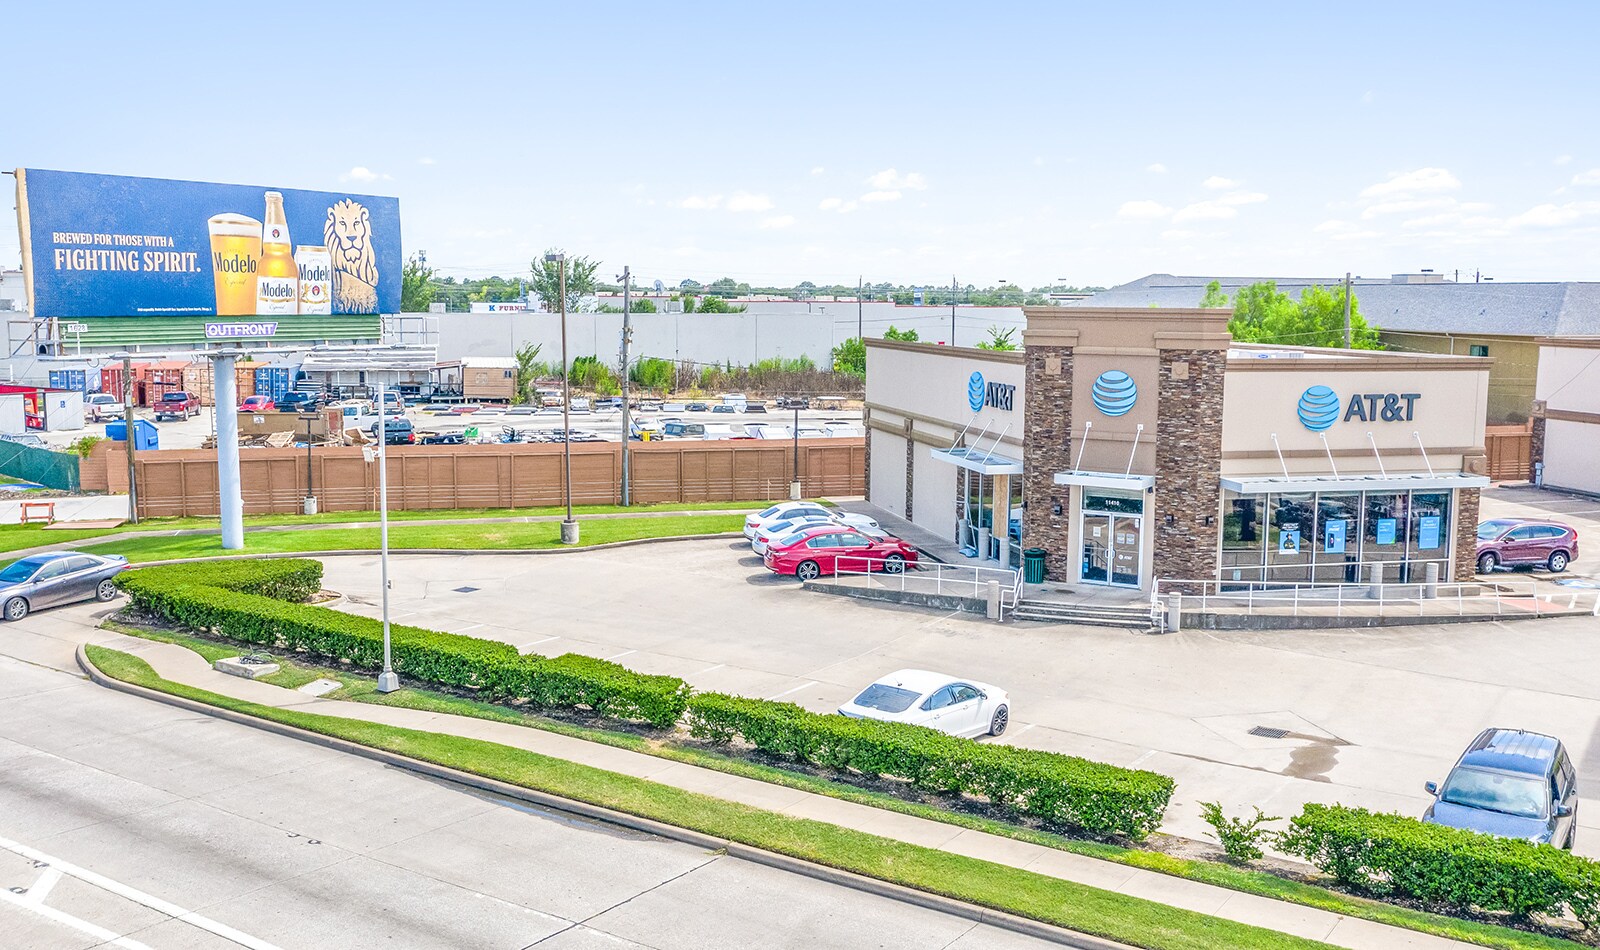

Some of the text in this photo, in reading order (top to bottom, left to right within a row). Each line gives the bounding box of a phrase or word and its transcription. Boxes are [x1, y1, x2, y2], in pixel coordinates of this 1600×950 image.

[53, 232, 174, 247] BREWED FOR THOSE WITH A
[54, 248, 201, 272] FIGHTING SPIRIT.
[214, 251, 257, 274] Modelo
[262, 282, 293, 297] Modelo
[208, 325, 274, 336] OUTFRONT
[984, 381, 1016, 412] AT&T
[1343, 393, 1421, 422] AT&T
